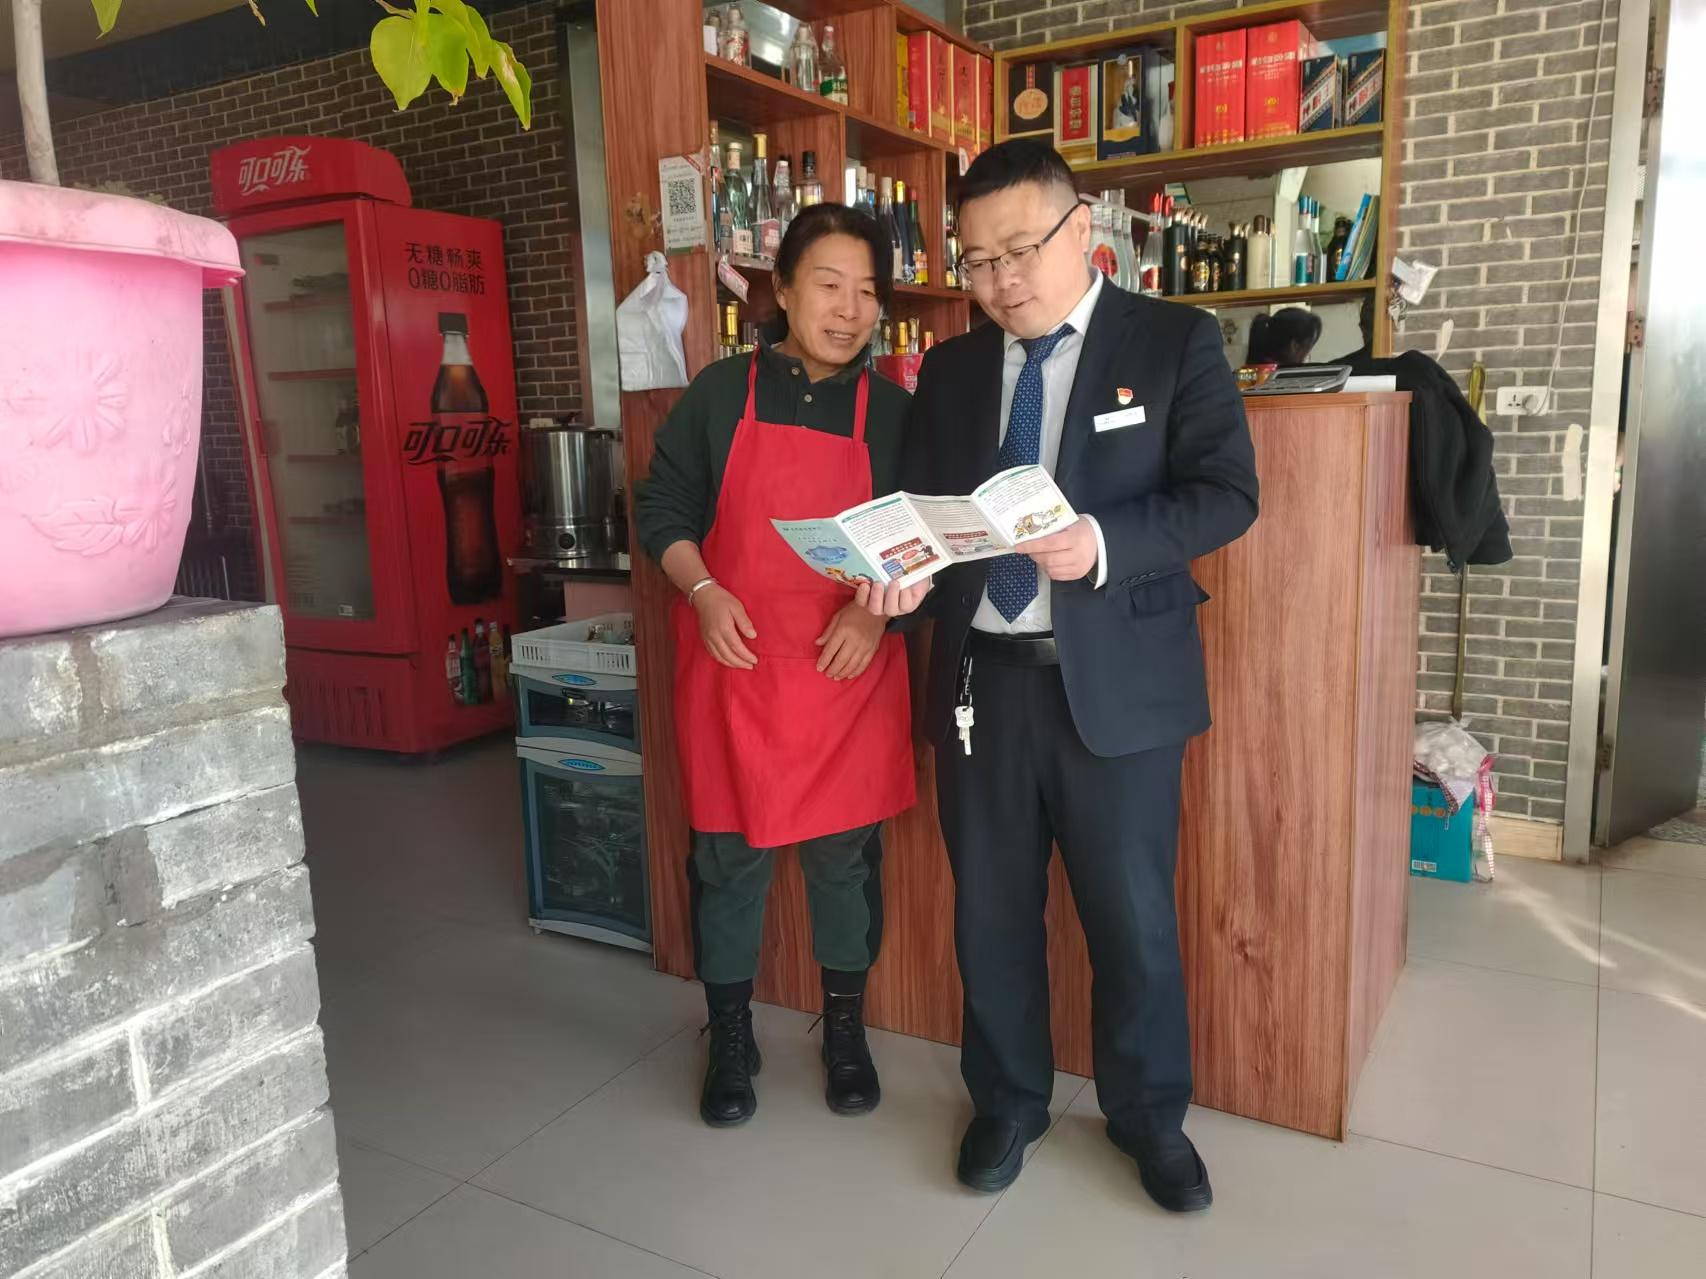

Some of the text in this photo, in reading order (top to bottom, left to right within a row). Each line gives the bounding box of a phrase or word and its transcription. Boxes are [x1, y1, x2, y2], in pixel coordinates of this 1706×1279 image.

[239, 146, 310, 194] 可口可乐
[406, 242, 481, 269] 无糖畅爽
[408, 268, 485, 295] 0糖0脂肪
[404, 416, 512, 465] 可口可乐
